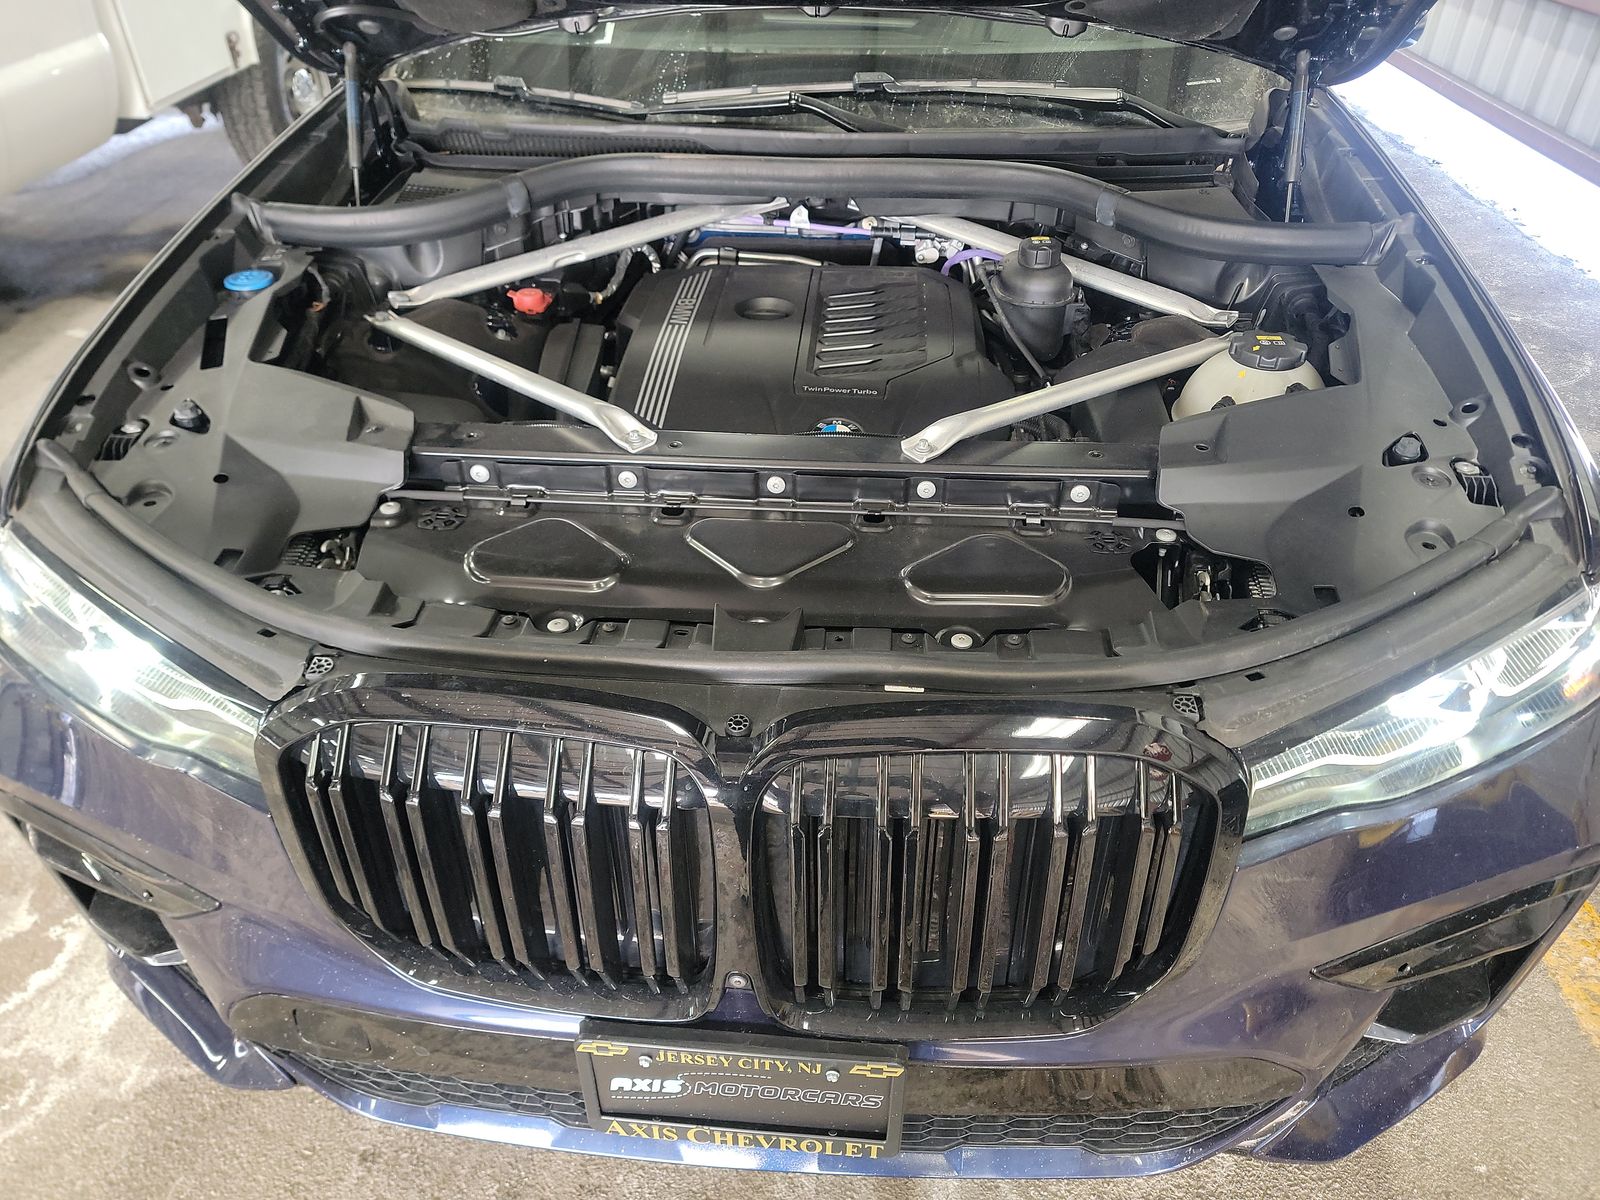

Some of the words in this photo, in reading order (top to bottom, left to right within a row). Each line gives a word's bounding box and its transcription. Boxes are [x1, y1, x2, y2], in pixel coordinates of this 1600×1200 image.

[669, 298, 697, 325] BMW
[655, 1049, 733, 1068] JERSEY
[737, 1058, 793, 1074] CITY,
[798, 1062, 822, 1075] NJ
[609, 1077, 684, 1094] AXIS
[693, 1081, 884, 1109] MOTORCARS
